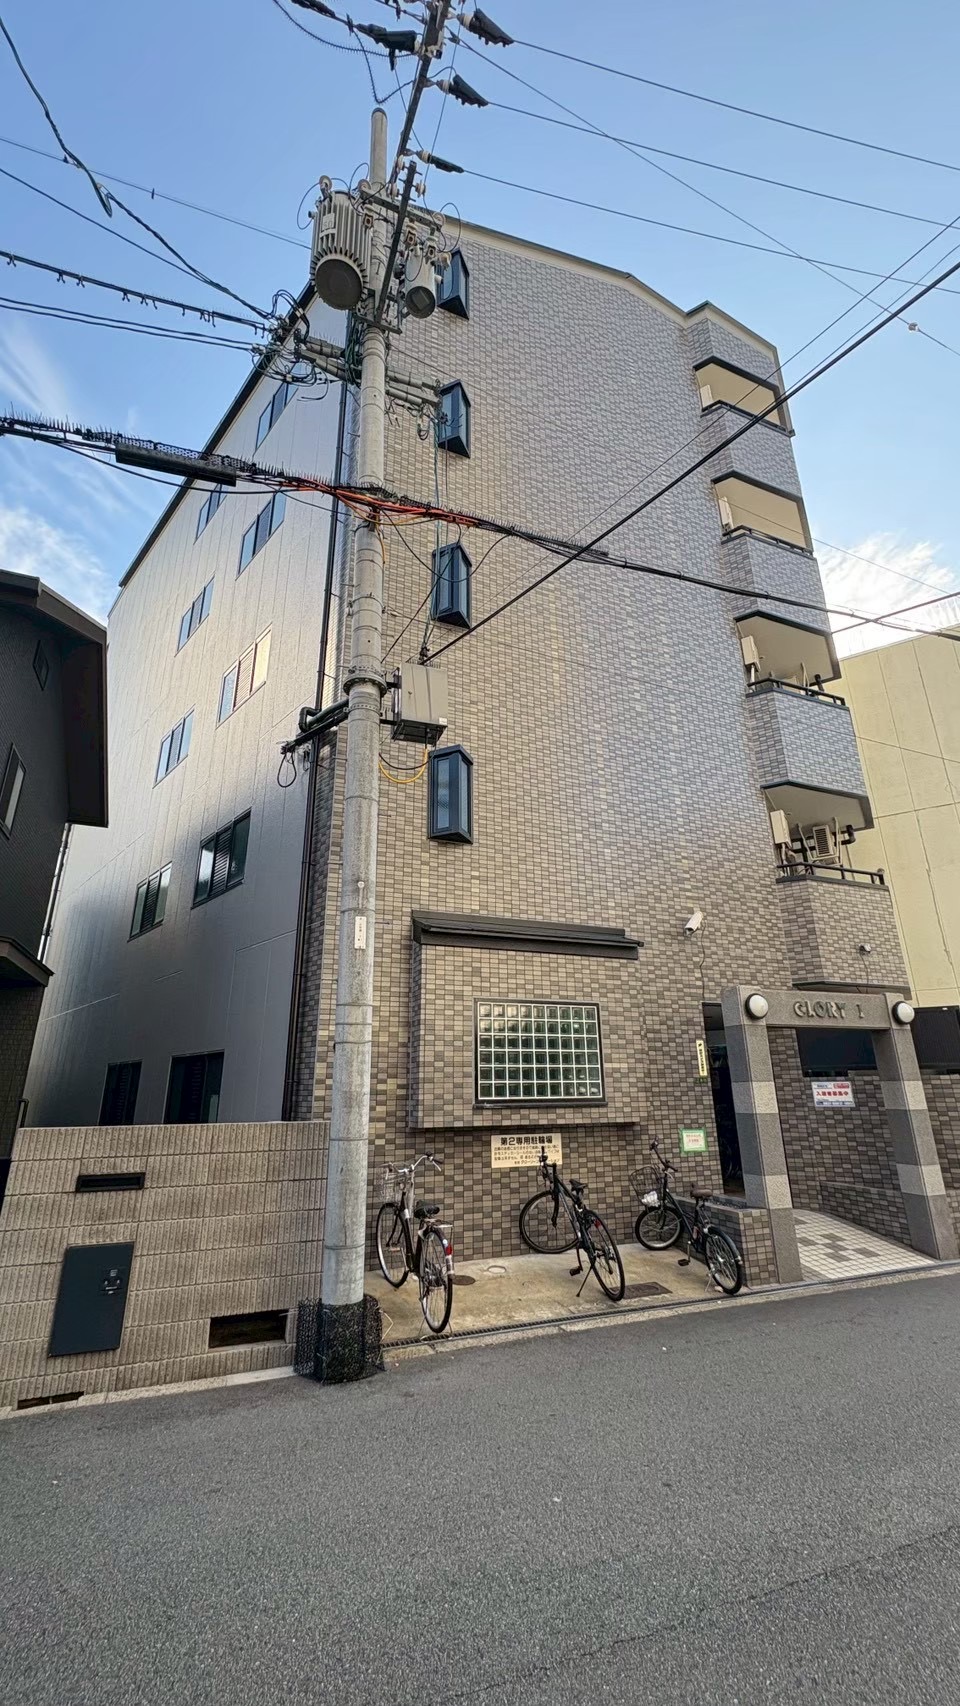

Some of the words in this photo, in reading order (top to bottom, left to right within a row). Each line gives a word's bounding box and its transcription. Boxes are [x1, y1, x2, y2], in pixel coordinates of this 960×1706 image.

[794, 1000, 846, 1019] GLORY
[500, 1135, 553, 1146] 第2専用駐輪場
